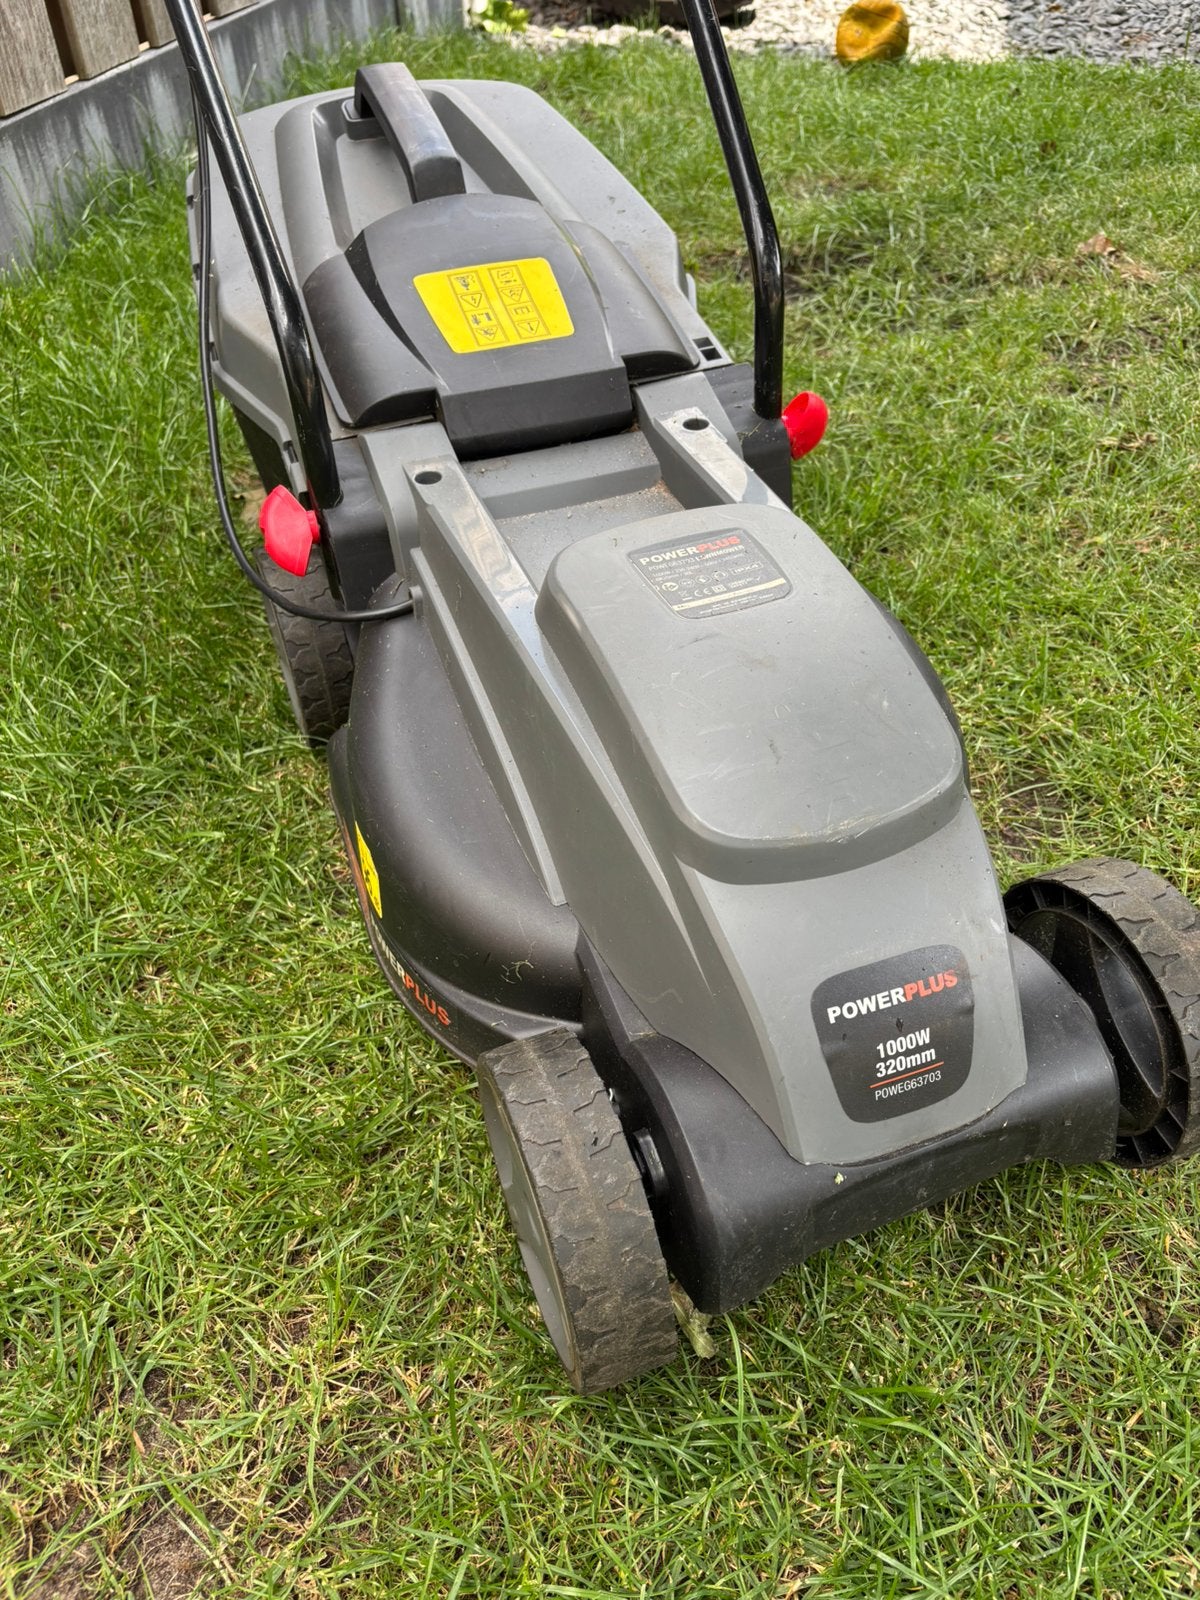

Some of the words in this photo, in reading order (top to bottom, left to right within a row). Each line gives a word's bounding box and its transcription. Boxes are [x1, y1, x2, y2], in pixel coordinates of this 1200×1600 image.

[639, 536, 741, 566] POWERPLUS
[827, 970, 958, 1024] POWERPLUS
[876, 1027, 931, 1058] 1000W
[876, 1048, 936, 1078] 320mm
[875, 1070, 942, 1101] POWEG63703
